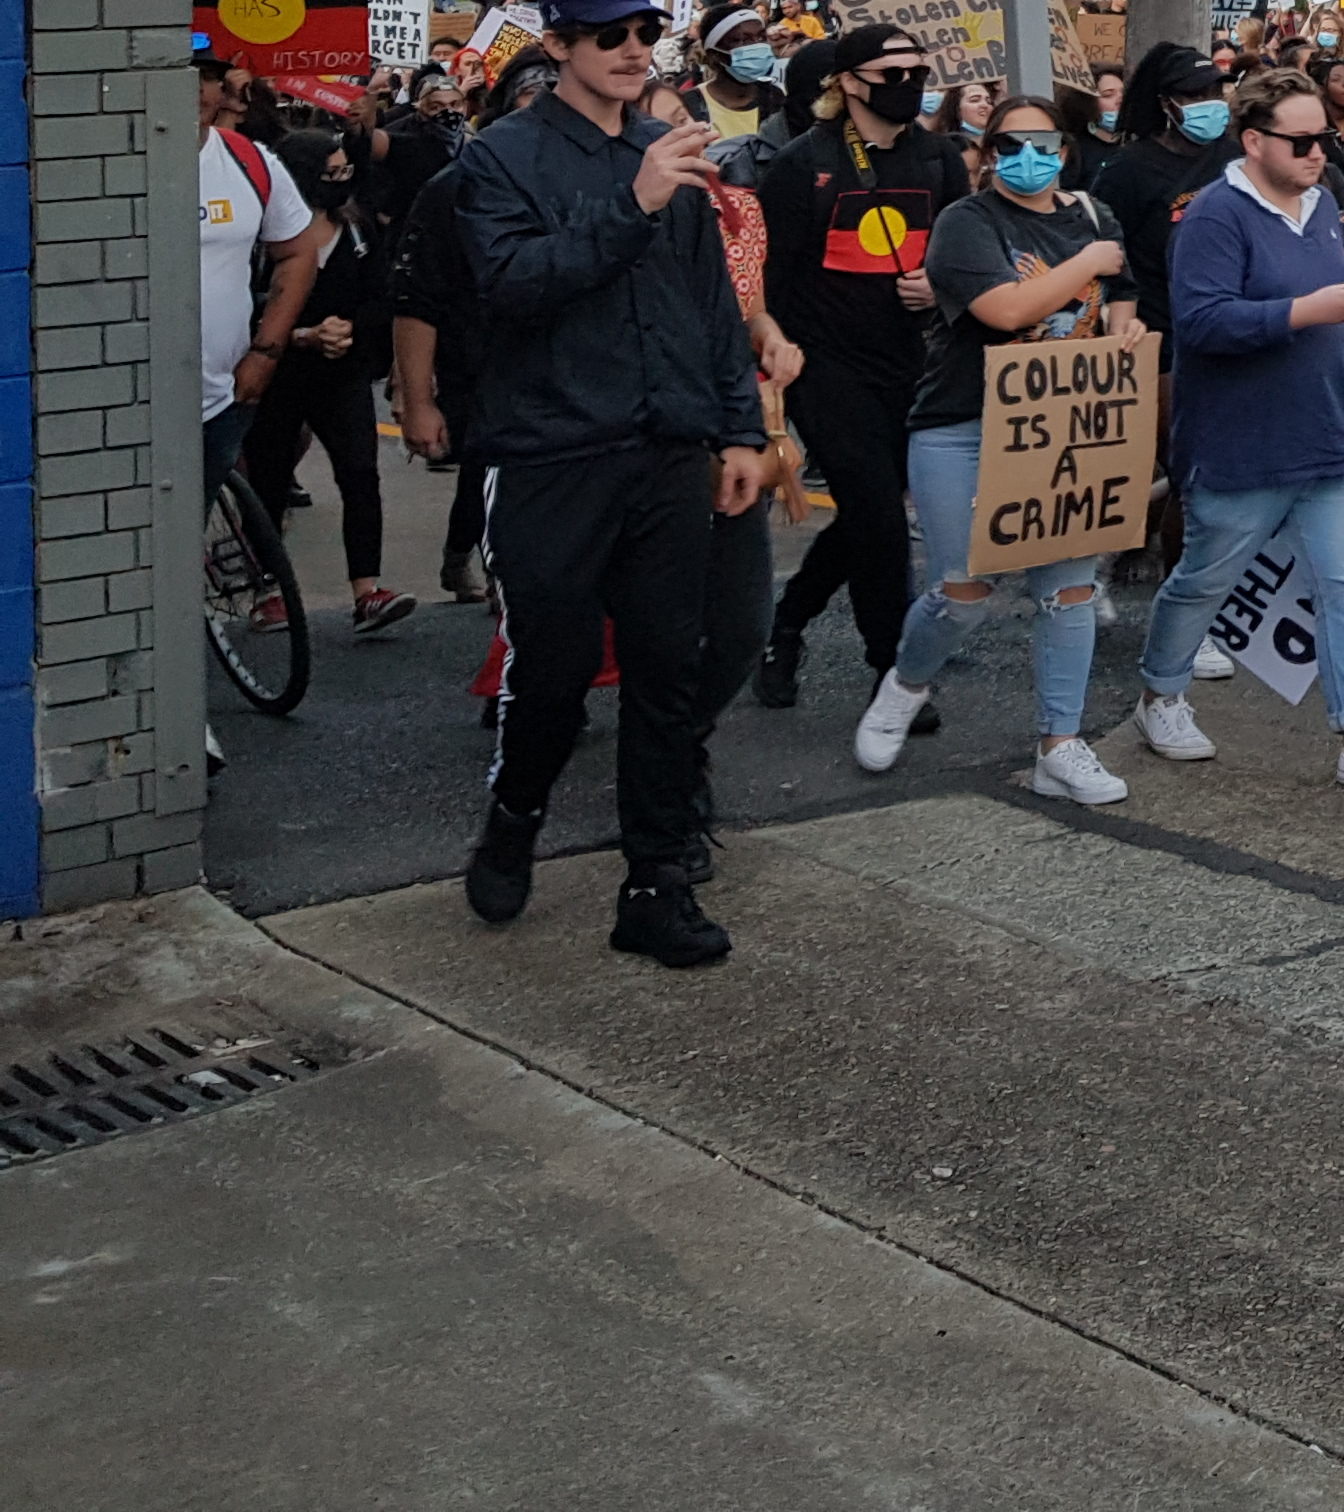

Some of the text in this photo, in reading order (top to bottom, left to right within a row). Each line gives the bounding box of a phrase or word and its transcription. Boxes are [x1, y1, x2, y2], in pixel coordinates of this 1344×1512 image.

[383, 24, 408, 38] ME
[413, 27, 422, 42] A
[1093, 21, 1114, 37] WE
[272, 50, 365, 70] HISTORY
[371, 40, 421, 60] RGET
[997, 350, 1138, 405] COLOUR
[1004, 397, 1138, 452] IS NOT
[1051, 448, 1078, 490] A
[989, 475, 1130, 546] CRIME
